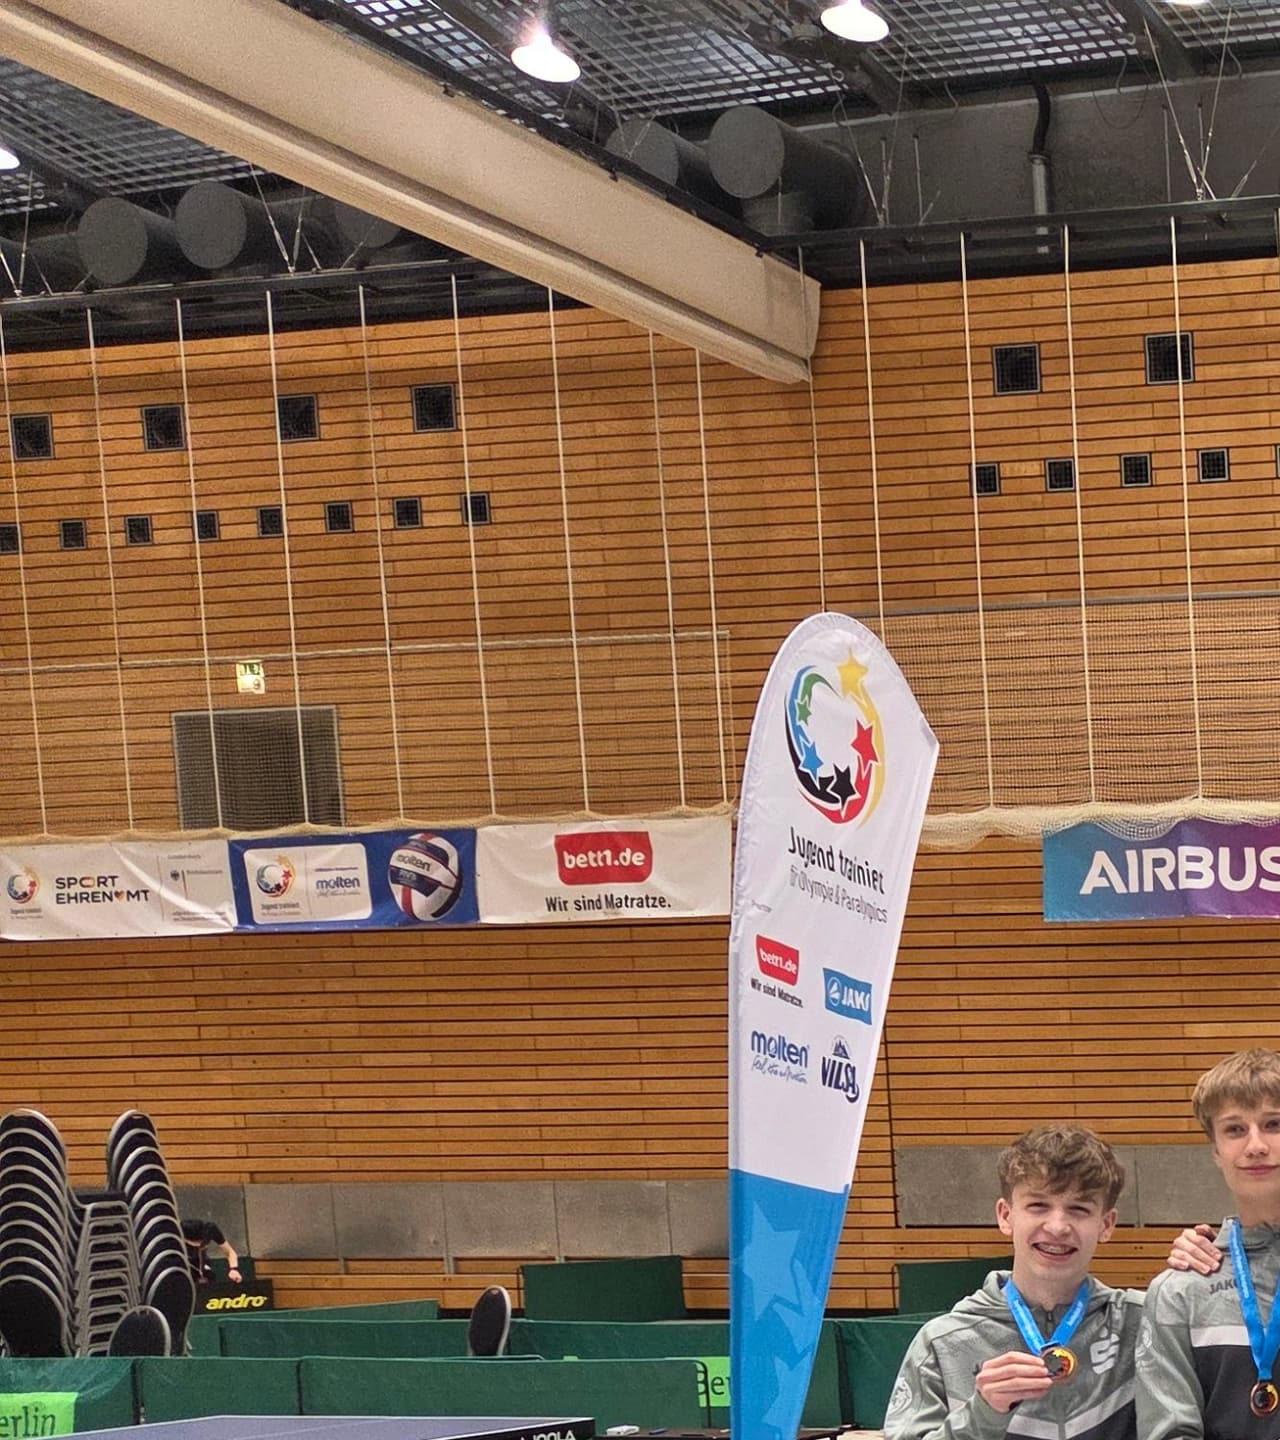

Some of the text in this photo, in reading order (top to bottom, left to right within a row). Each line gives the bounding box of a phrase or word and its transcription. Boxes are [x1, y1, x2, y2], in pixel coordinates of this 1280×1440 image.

[316, 874, 361, 890] molten
[545, 896, 568, 912] Wir
[574, 894, 602, 911] sind
[751, 1030, 808, 1067] molten
[206, 1293, 264, 1310] andro
[0, 1402, 56, 1438] erlin
